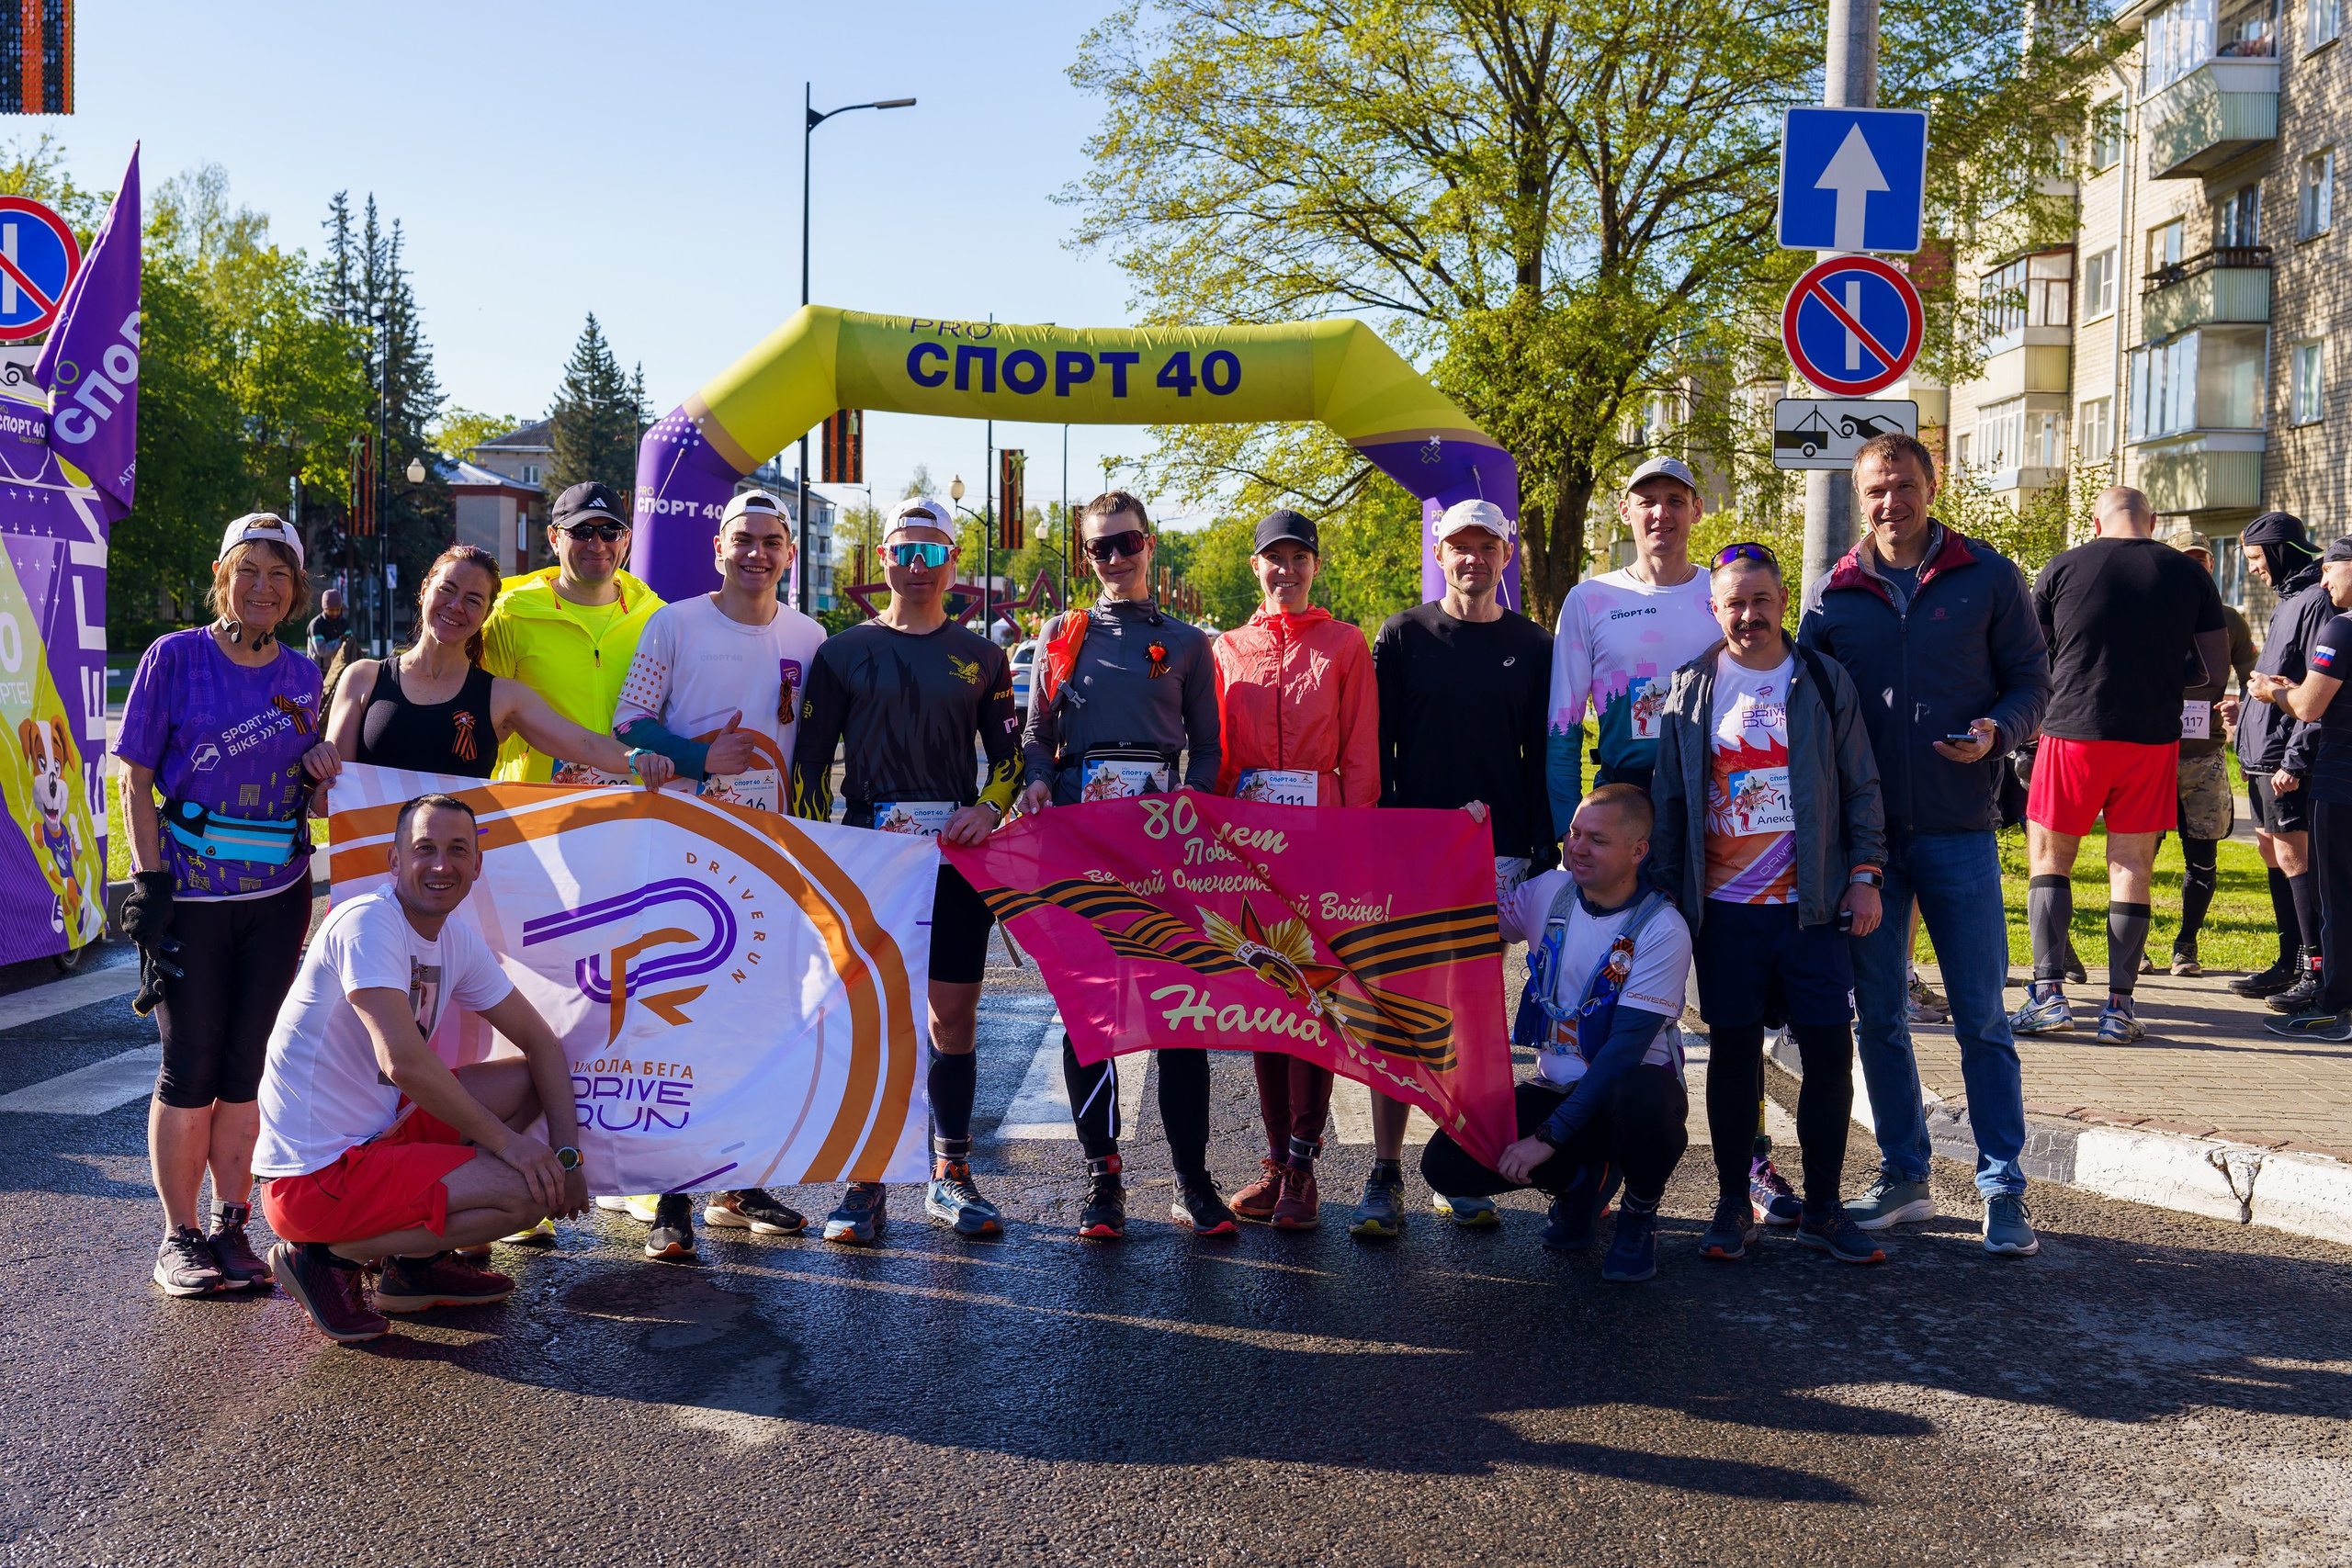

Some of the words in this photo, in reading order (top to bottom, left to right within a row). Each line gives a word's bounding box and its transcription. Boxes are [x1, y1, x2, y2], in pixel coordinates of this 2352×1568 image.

[910, 318, 991, 340] PRO
[907, 342, 1139, 398] СПОРТ
[1157, 350, 1241, 397] 40
[33, 422, 46, 438] 40
[639, 485, 655, 496] PRO
[637, 497, 699, 517] СПОРТ
[1431, 510, 1444, 520] PR
[1611, 609, 1643, 620] СПОРТ
[221, 715, 262, 743] SPORT
[266, 692, 312, 719] MAFON
[2184, 716, 2203, 727] 117
[228, 734, 259, 757] BIKE
[1276, 795, 1305, 807] 111
[1138, 795, 1199, 840] 80
[1210, 821, 1289, 855] лет
[1318, 892, 1393, 923] Войне!
[1626, 991, 1679, 1009] DRIVERUN
[1150, 984, 1328, 1047] Наша
[643, 1061, 694, 1080] БЕГА
[571, 1076, 694, 1107] DRIVE
[576, 1103, 689, 1133] RUN
